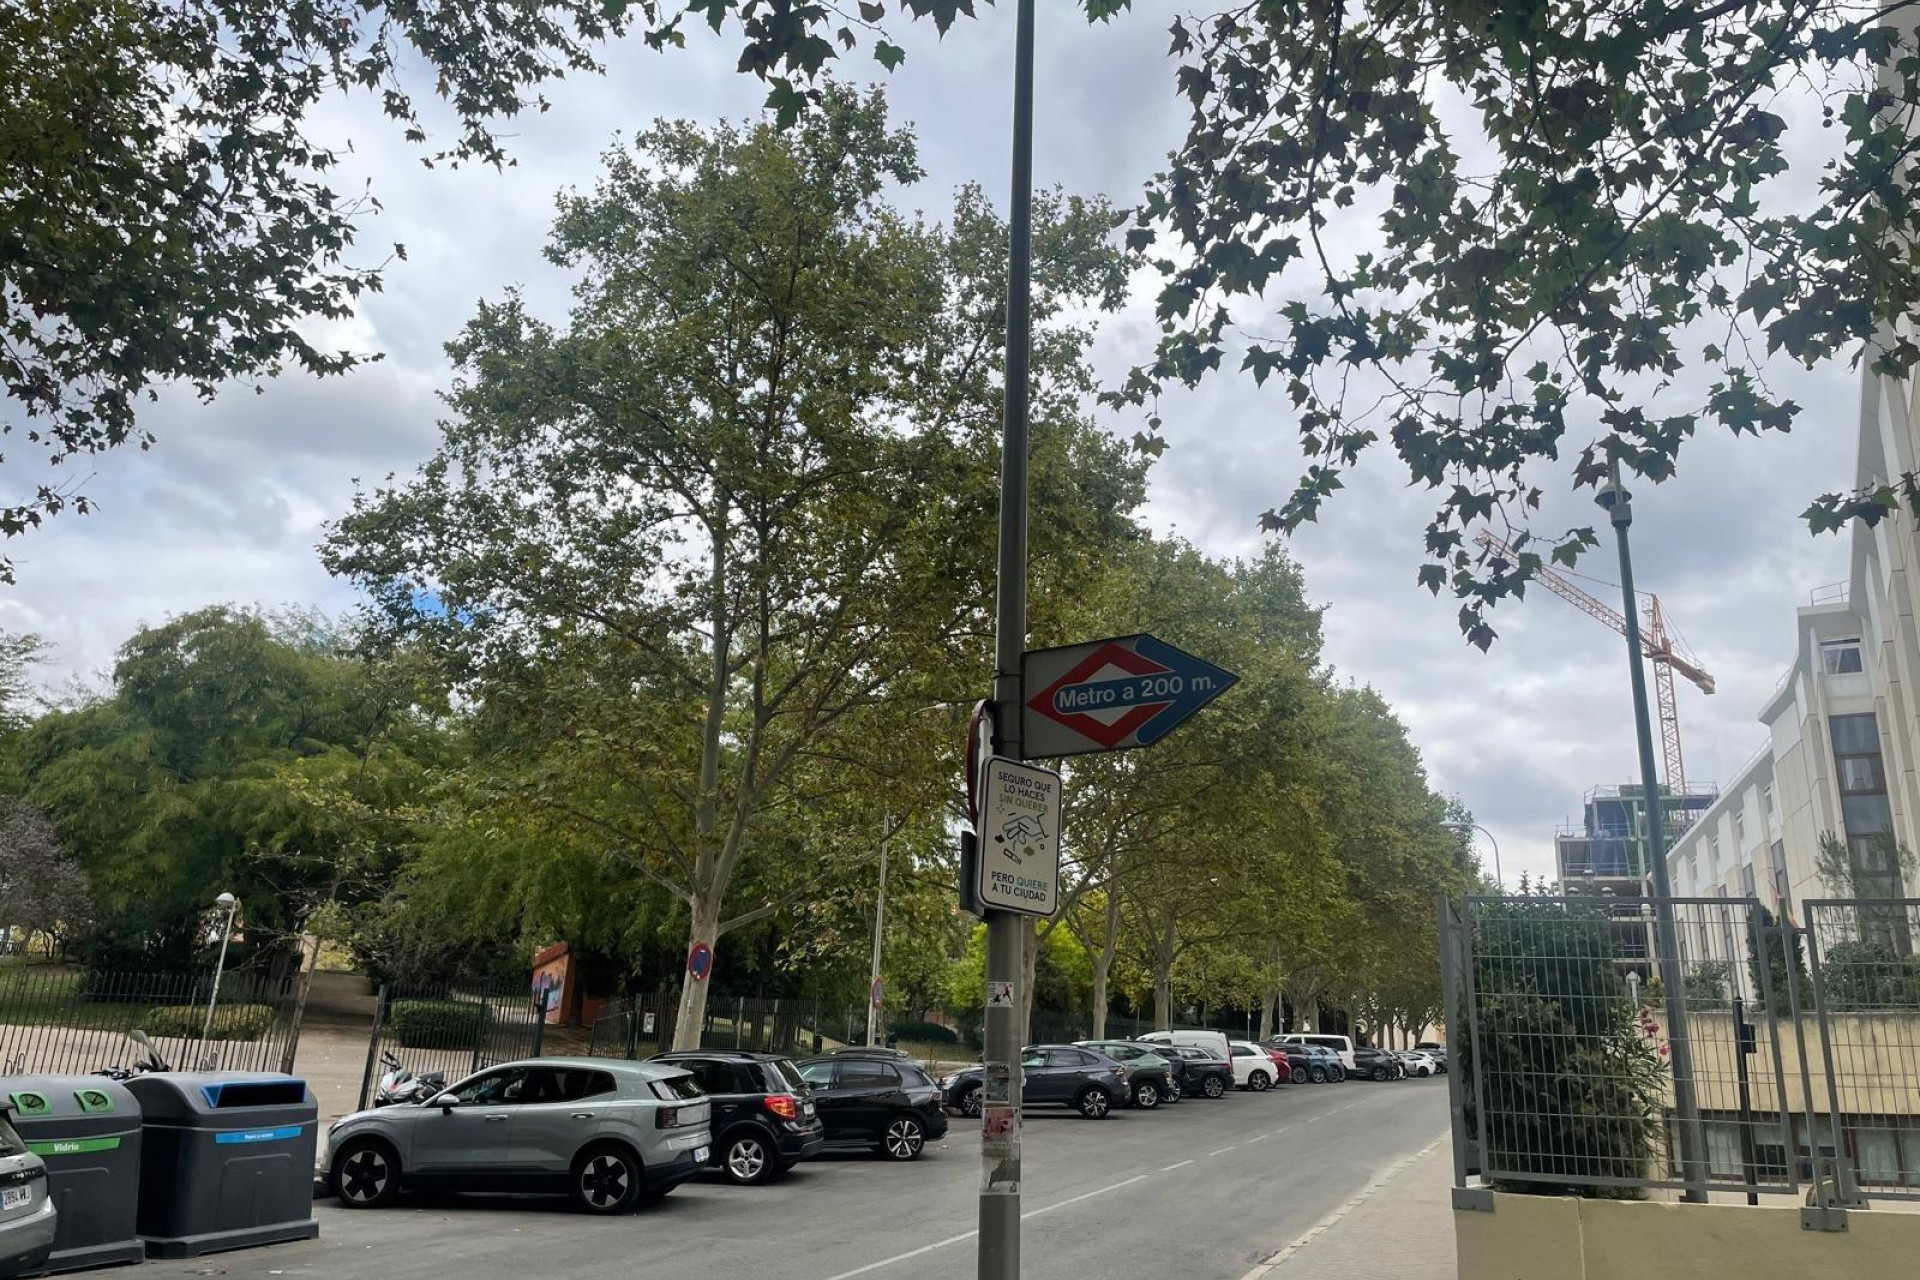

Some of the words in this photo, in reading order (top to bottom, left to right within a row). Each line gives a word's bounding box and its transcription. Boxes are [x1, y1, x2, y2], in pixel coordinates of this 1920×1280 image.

[1059, 688, 1115, 708] Metro
[1122, 686, 1134, 700] a
[1141, 676, 1183, 697] 200
[1192, 676, 1217, 691] m.
[998, 771, 1033, 787] SEGURO
[1034, 781, 1052, 793] QUE
[1004, 784, 1016, 794] LO
[1018, 788, 1045, 802] HACES
[999, 794, 1013, 804] SIN
[1015, 797, 1049, 813] QUERER
[991, 871, 1015, 884] PERO
[1017, 877, 1048, 891] QUIERE
[992, 882, 998, 893] A
[1001, 884, 1011, 895] TU
[1014, 887, 1046, 902] CIUDAD
[54, 1143, 79, 1152] Vidrio
